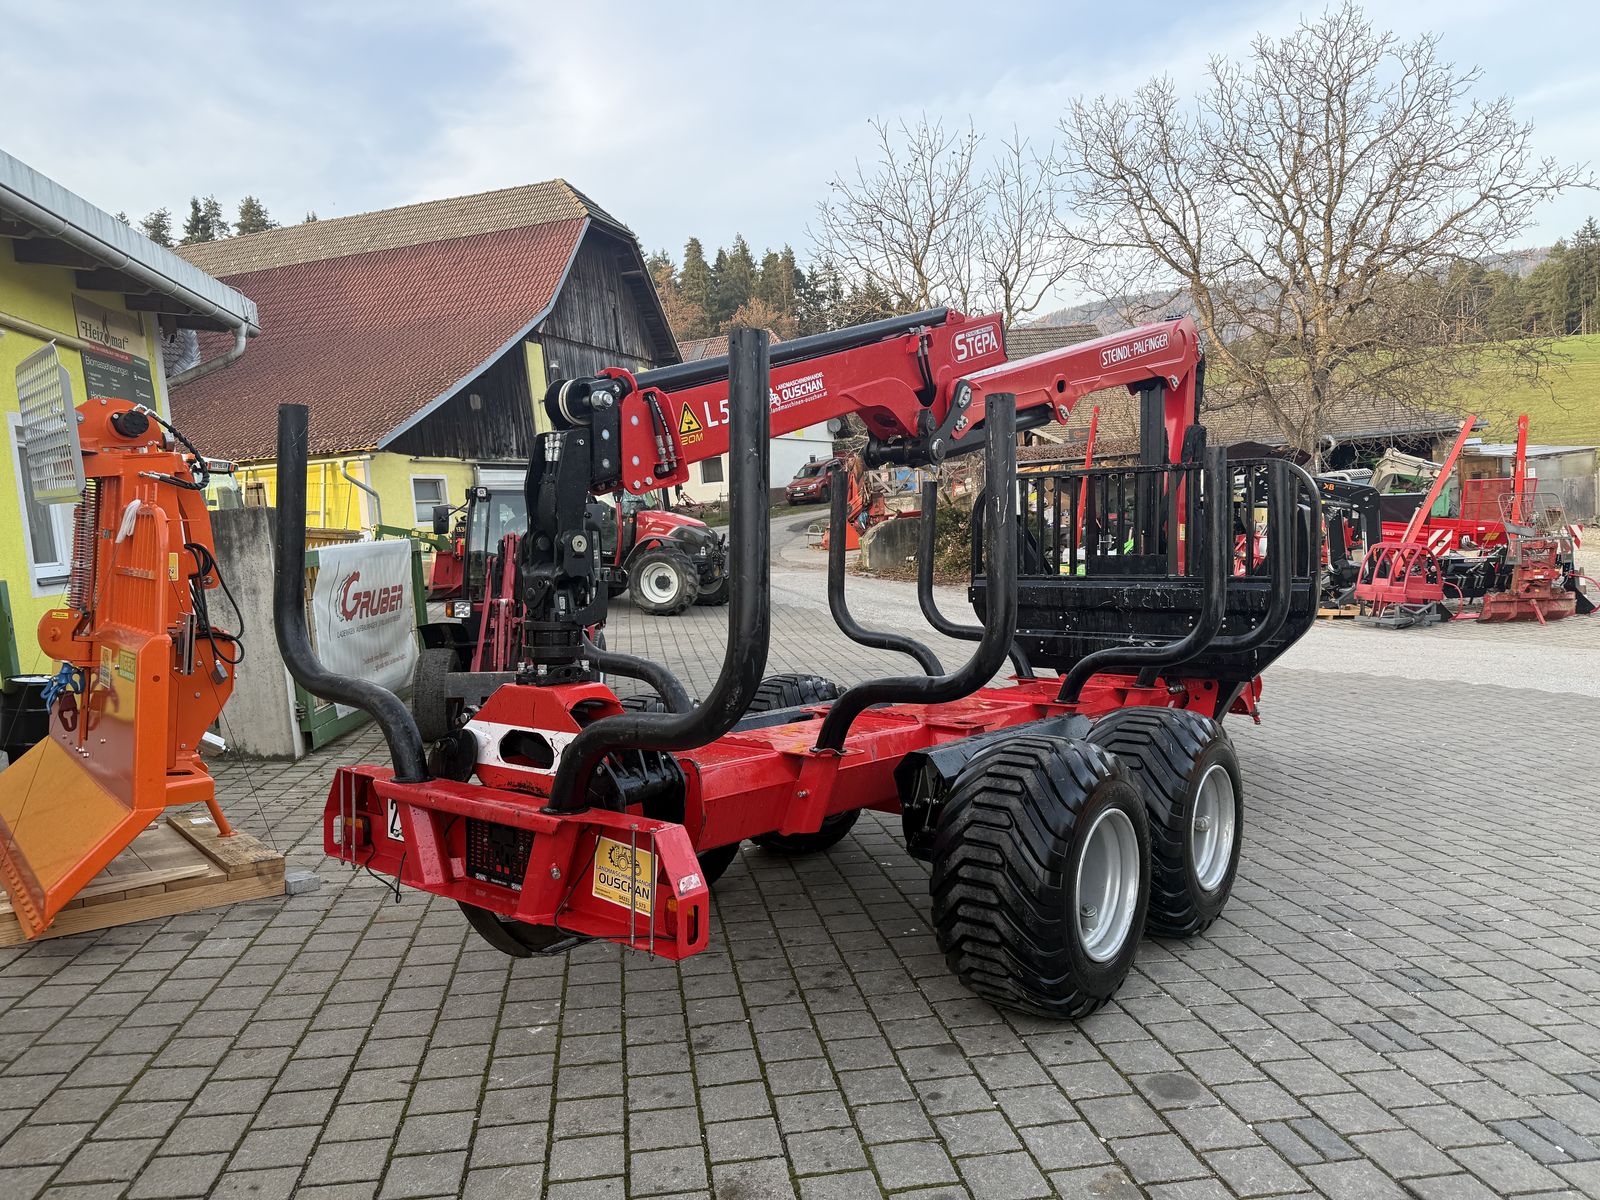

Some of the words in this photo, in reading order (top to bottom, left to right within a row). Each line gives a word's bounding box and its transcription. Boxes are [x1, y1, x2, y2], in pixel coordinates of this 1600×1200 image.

[955, 331, 998, 361] STEPA
[1102, 333, 1168, 366] STEINDL-PALFINGER
[782, 378, 823, 401] OUSCHAN
[341, 571, 403, 622] GRUBER
[599, 872, 650, 900] OUSCHAN
